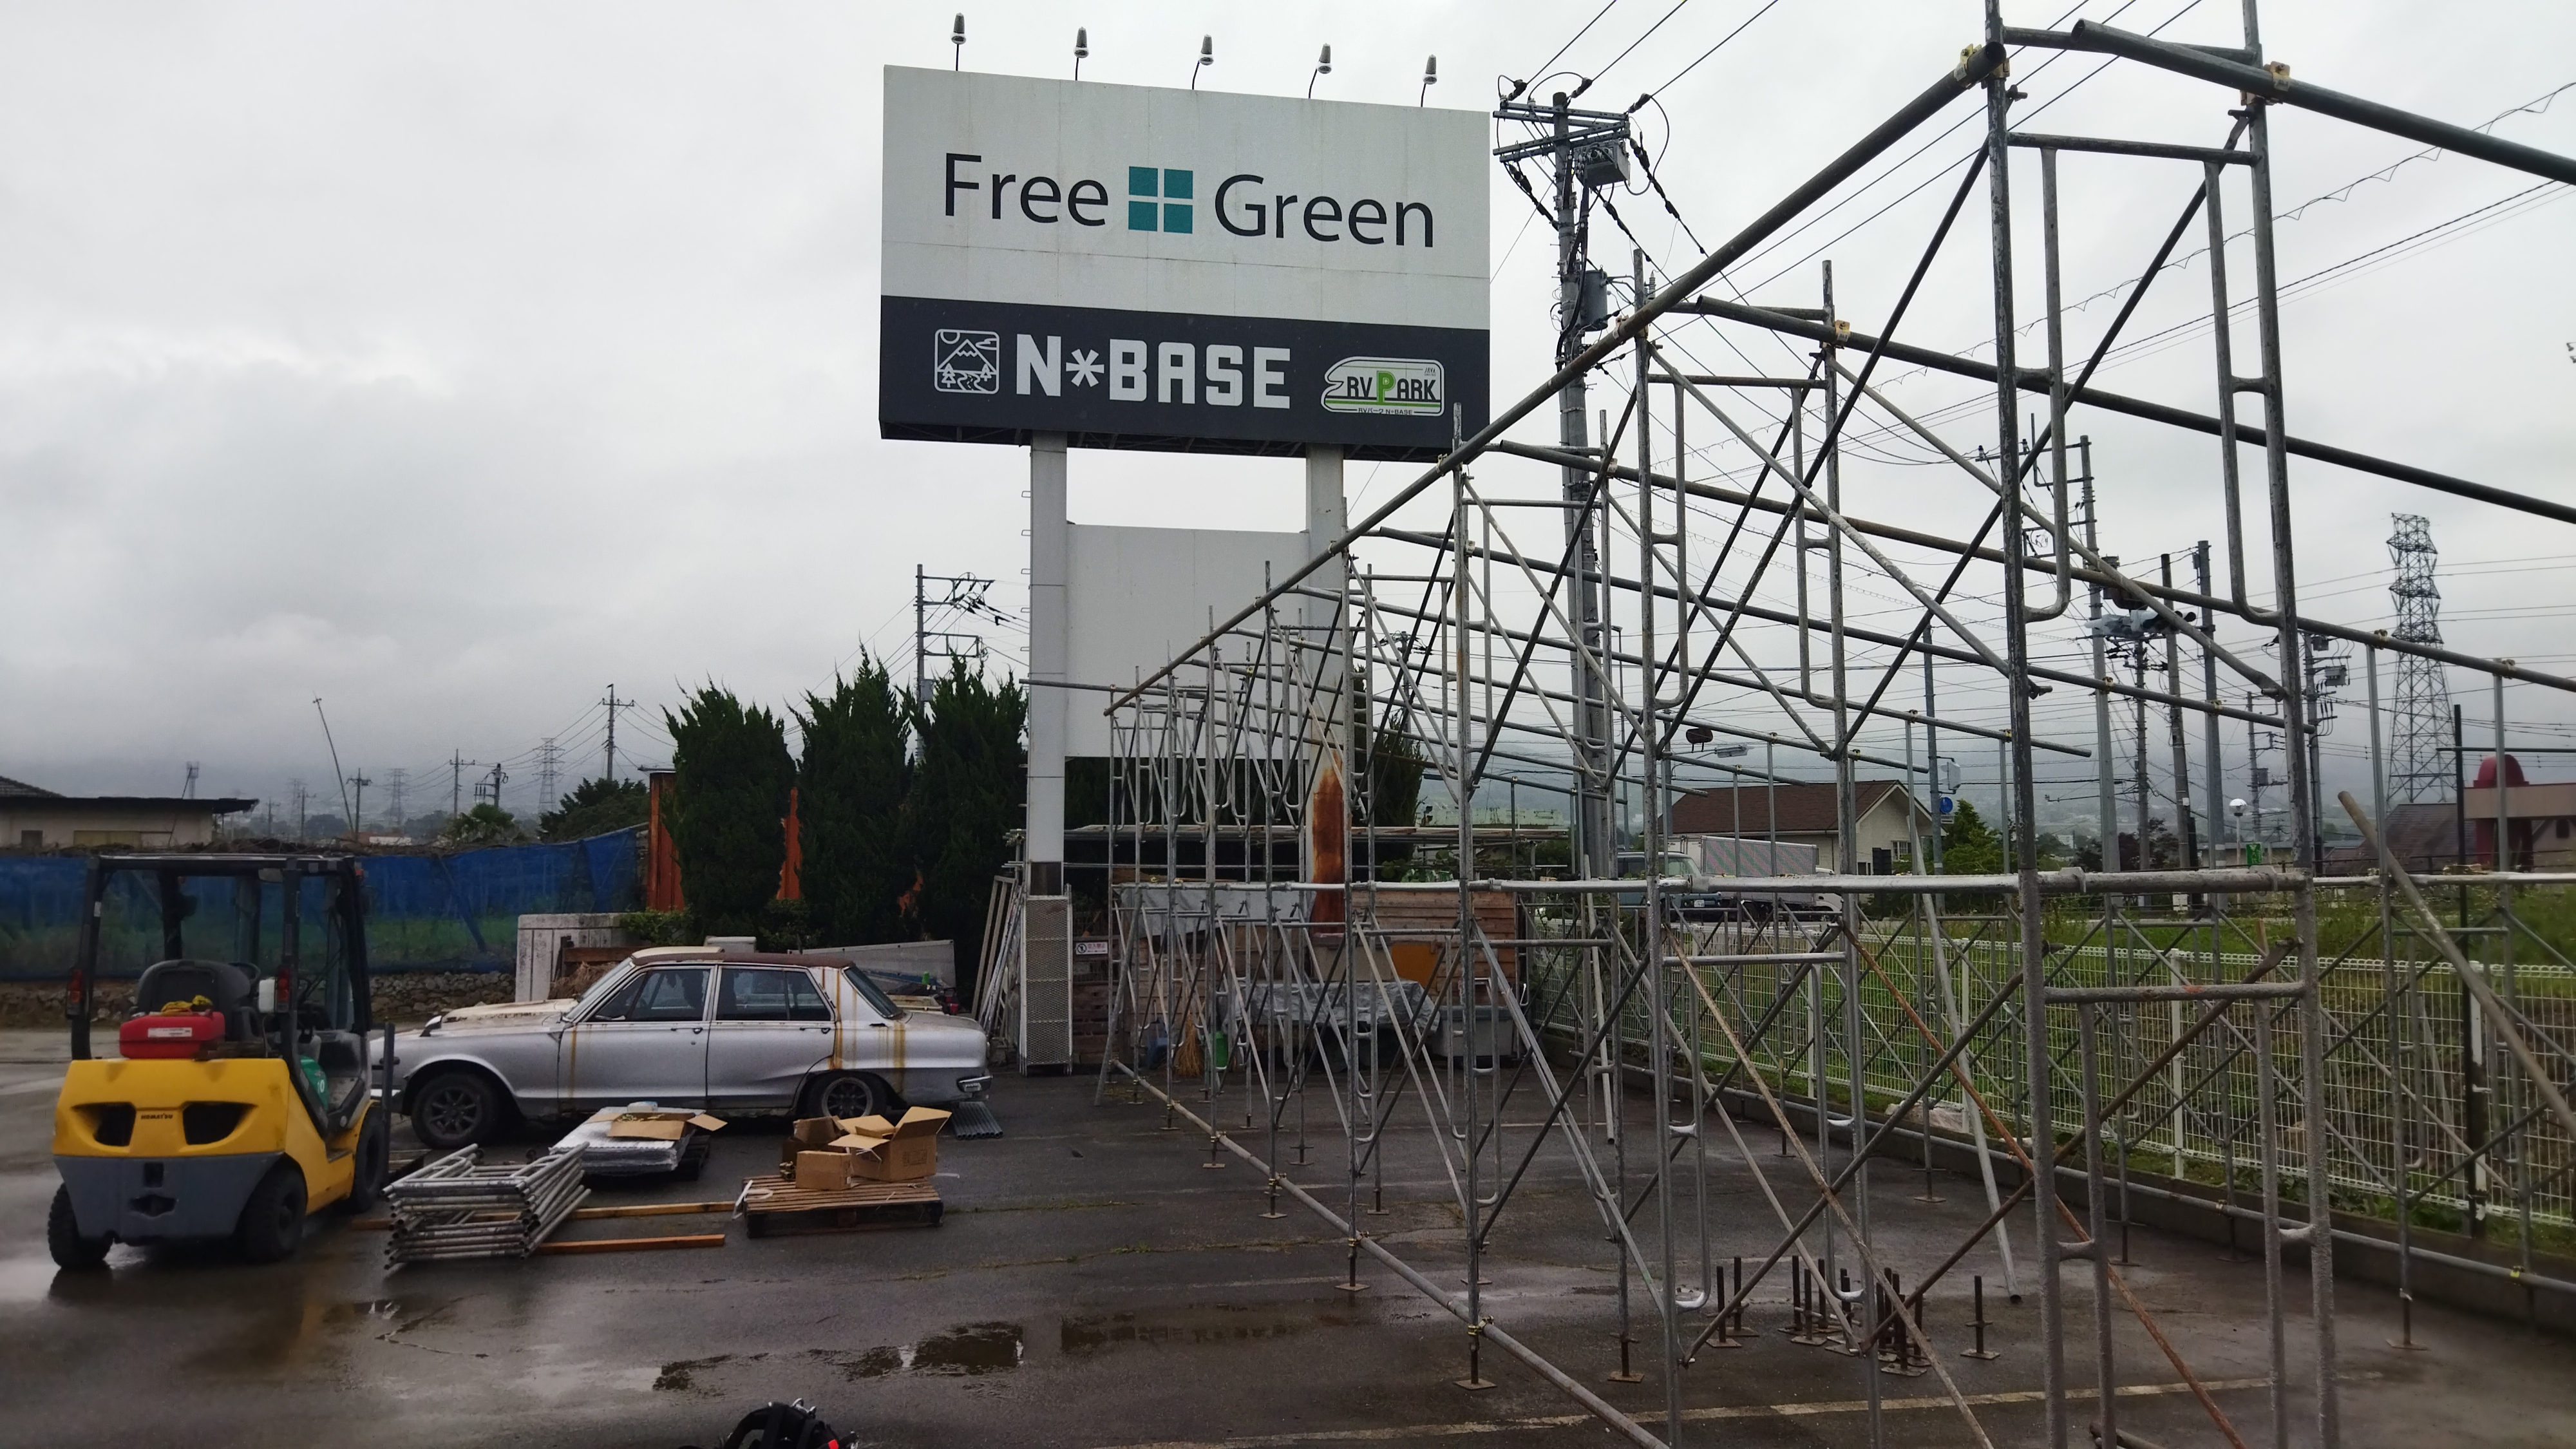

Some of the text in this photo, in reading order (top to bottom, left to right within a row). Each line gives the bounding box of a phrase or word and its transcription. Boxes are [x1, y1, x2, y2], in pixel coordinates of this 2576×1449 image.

[945, 153, 1434, 248] Free Green
[1347, 370, 1436, 404] RV PARK
